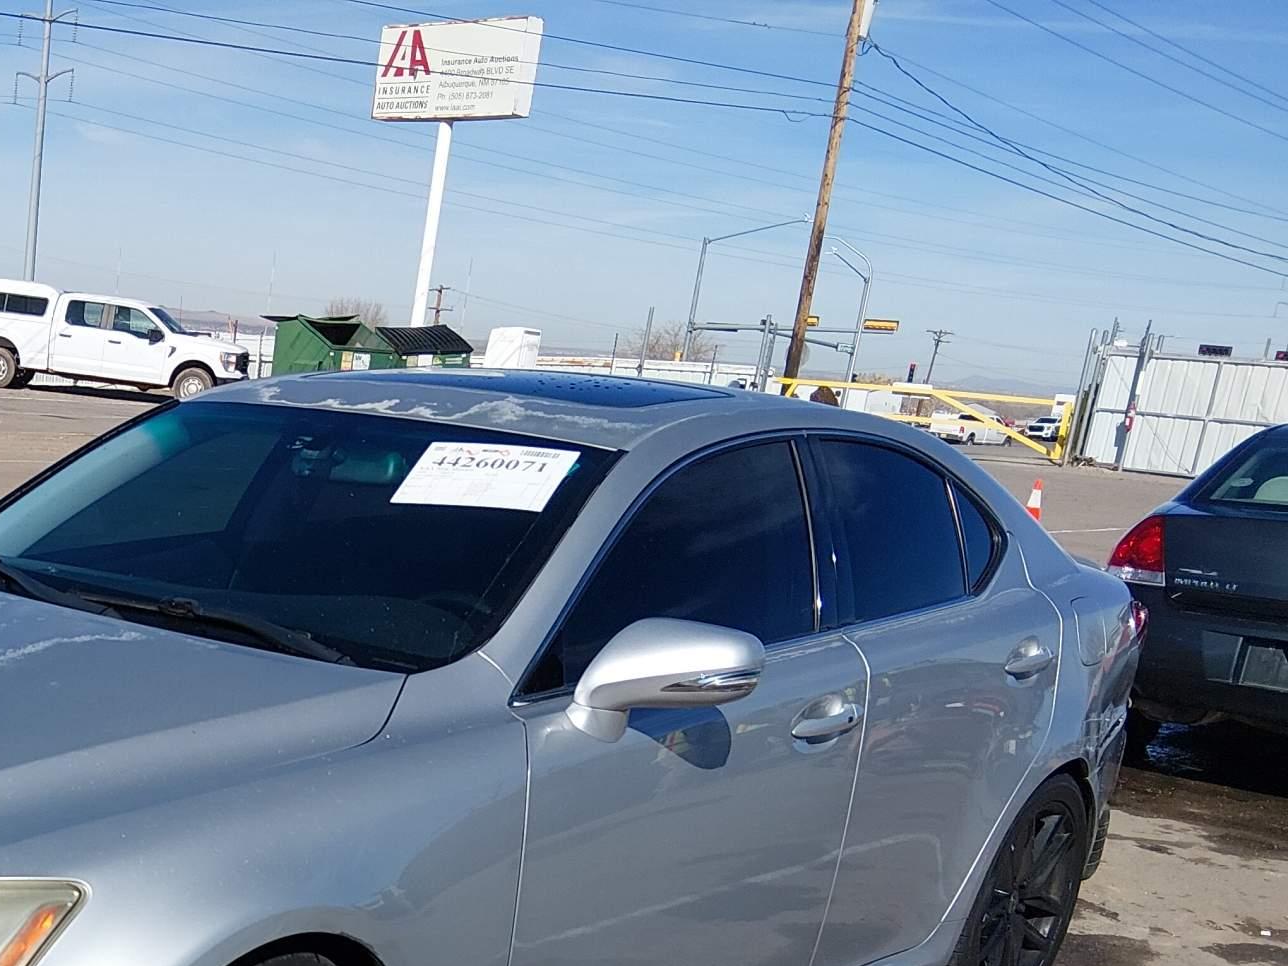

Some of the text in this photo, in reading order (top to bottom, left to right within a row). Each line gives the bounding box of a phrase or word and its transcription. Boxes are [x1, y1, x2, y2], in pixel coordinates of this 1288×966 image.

[441, 58, 472, 66] Insurance
[486, 66, 503, 75] BLVD
[505, 65, 515, 74] SE
[378, 85, 431, 95] INSURANCE
[376, 100, 429, 110] AUTO AUCTIONS
[432, 456, 548, 473] 44260071
